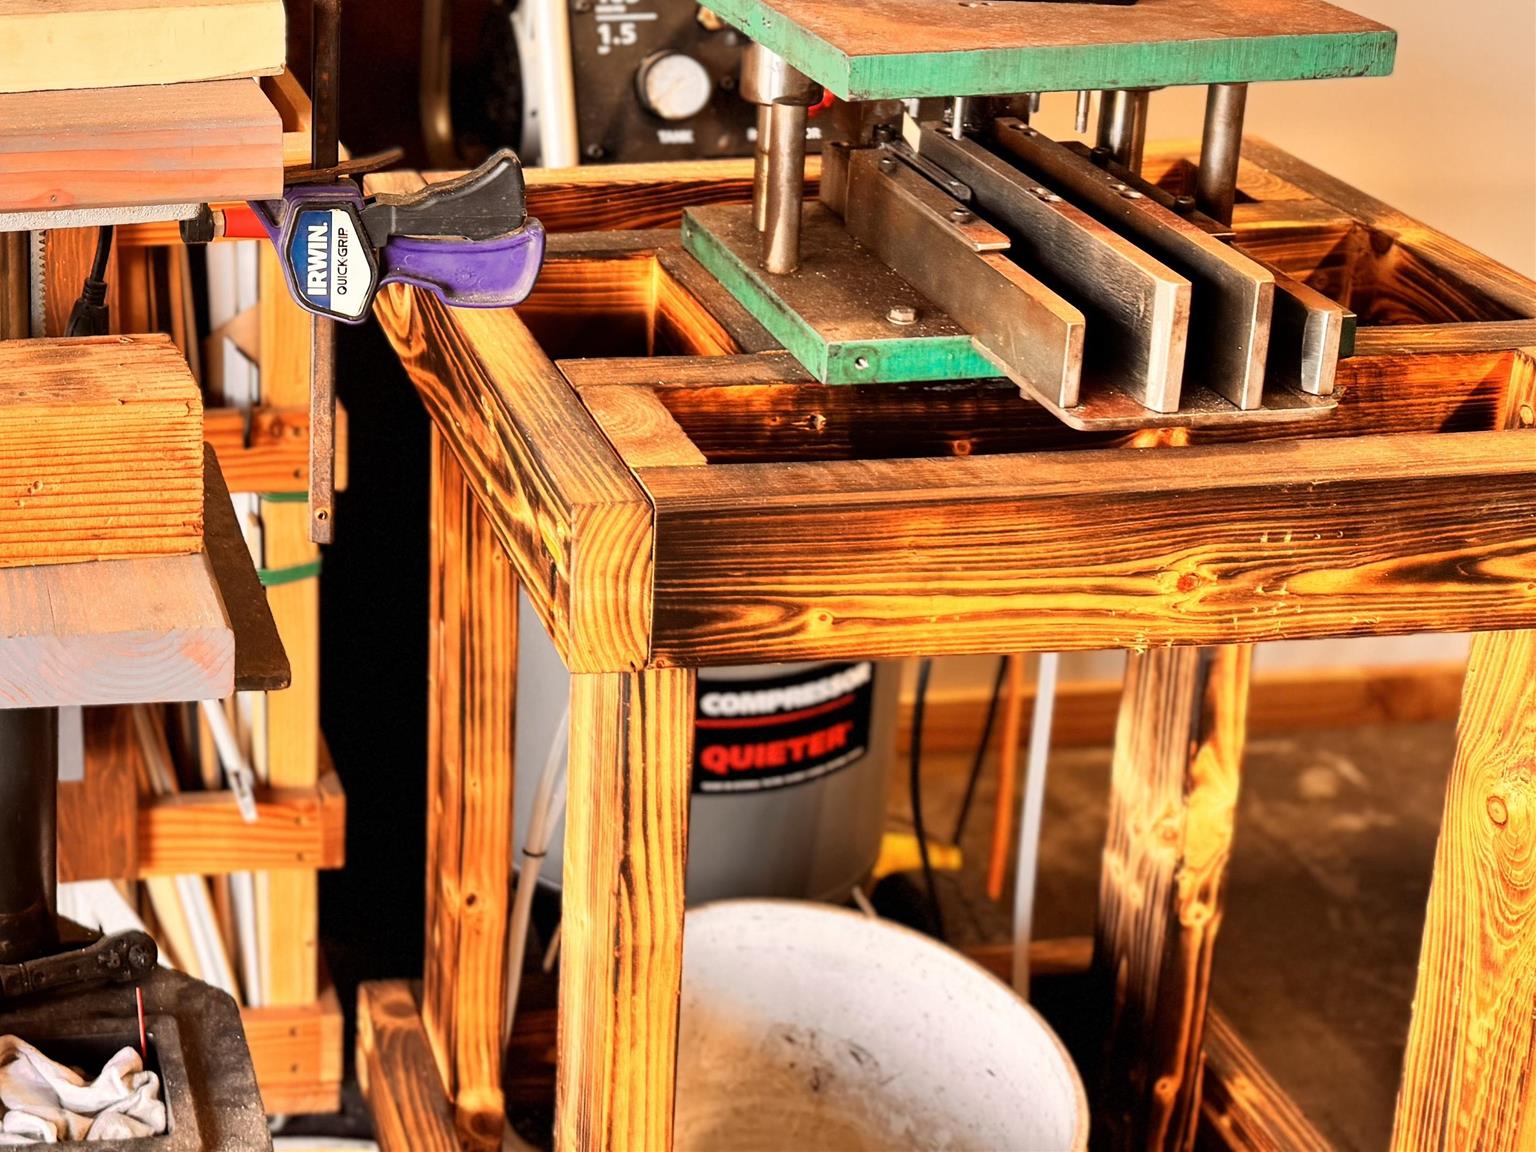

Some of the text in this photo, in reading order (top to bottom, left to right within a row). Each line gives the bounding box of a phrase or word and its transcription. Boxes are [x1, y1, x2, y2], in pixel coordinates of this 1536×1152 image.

[598, 23, 637, 45] 1.5
[308, 225, 328, 296] IRWIN
[700, 722, 850, 776] QUIETER
